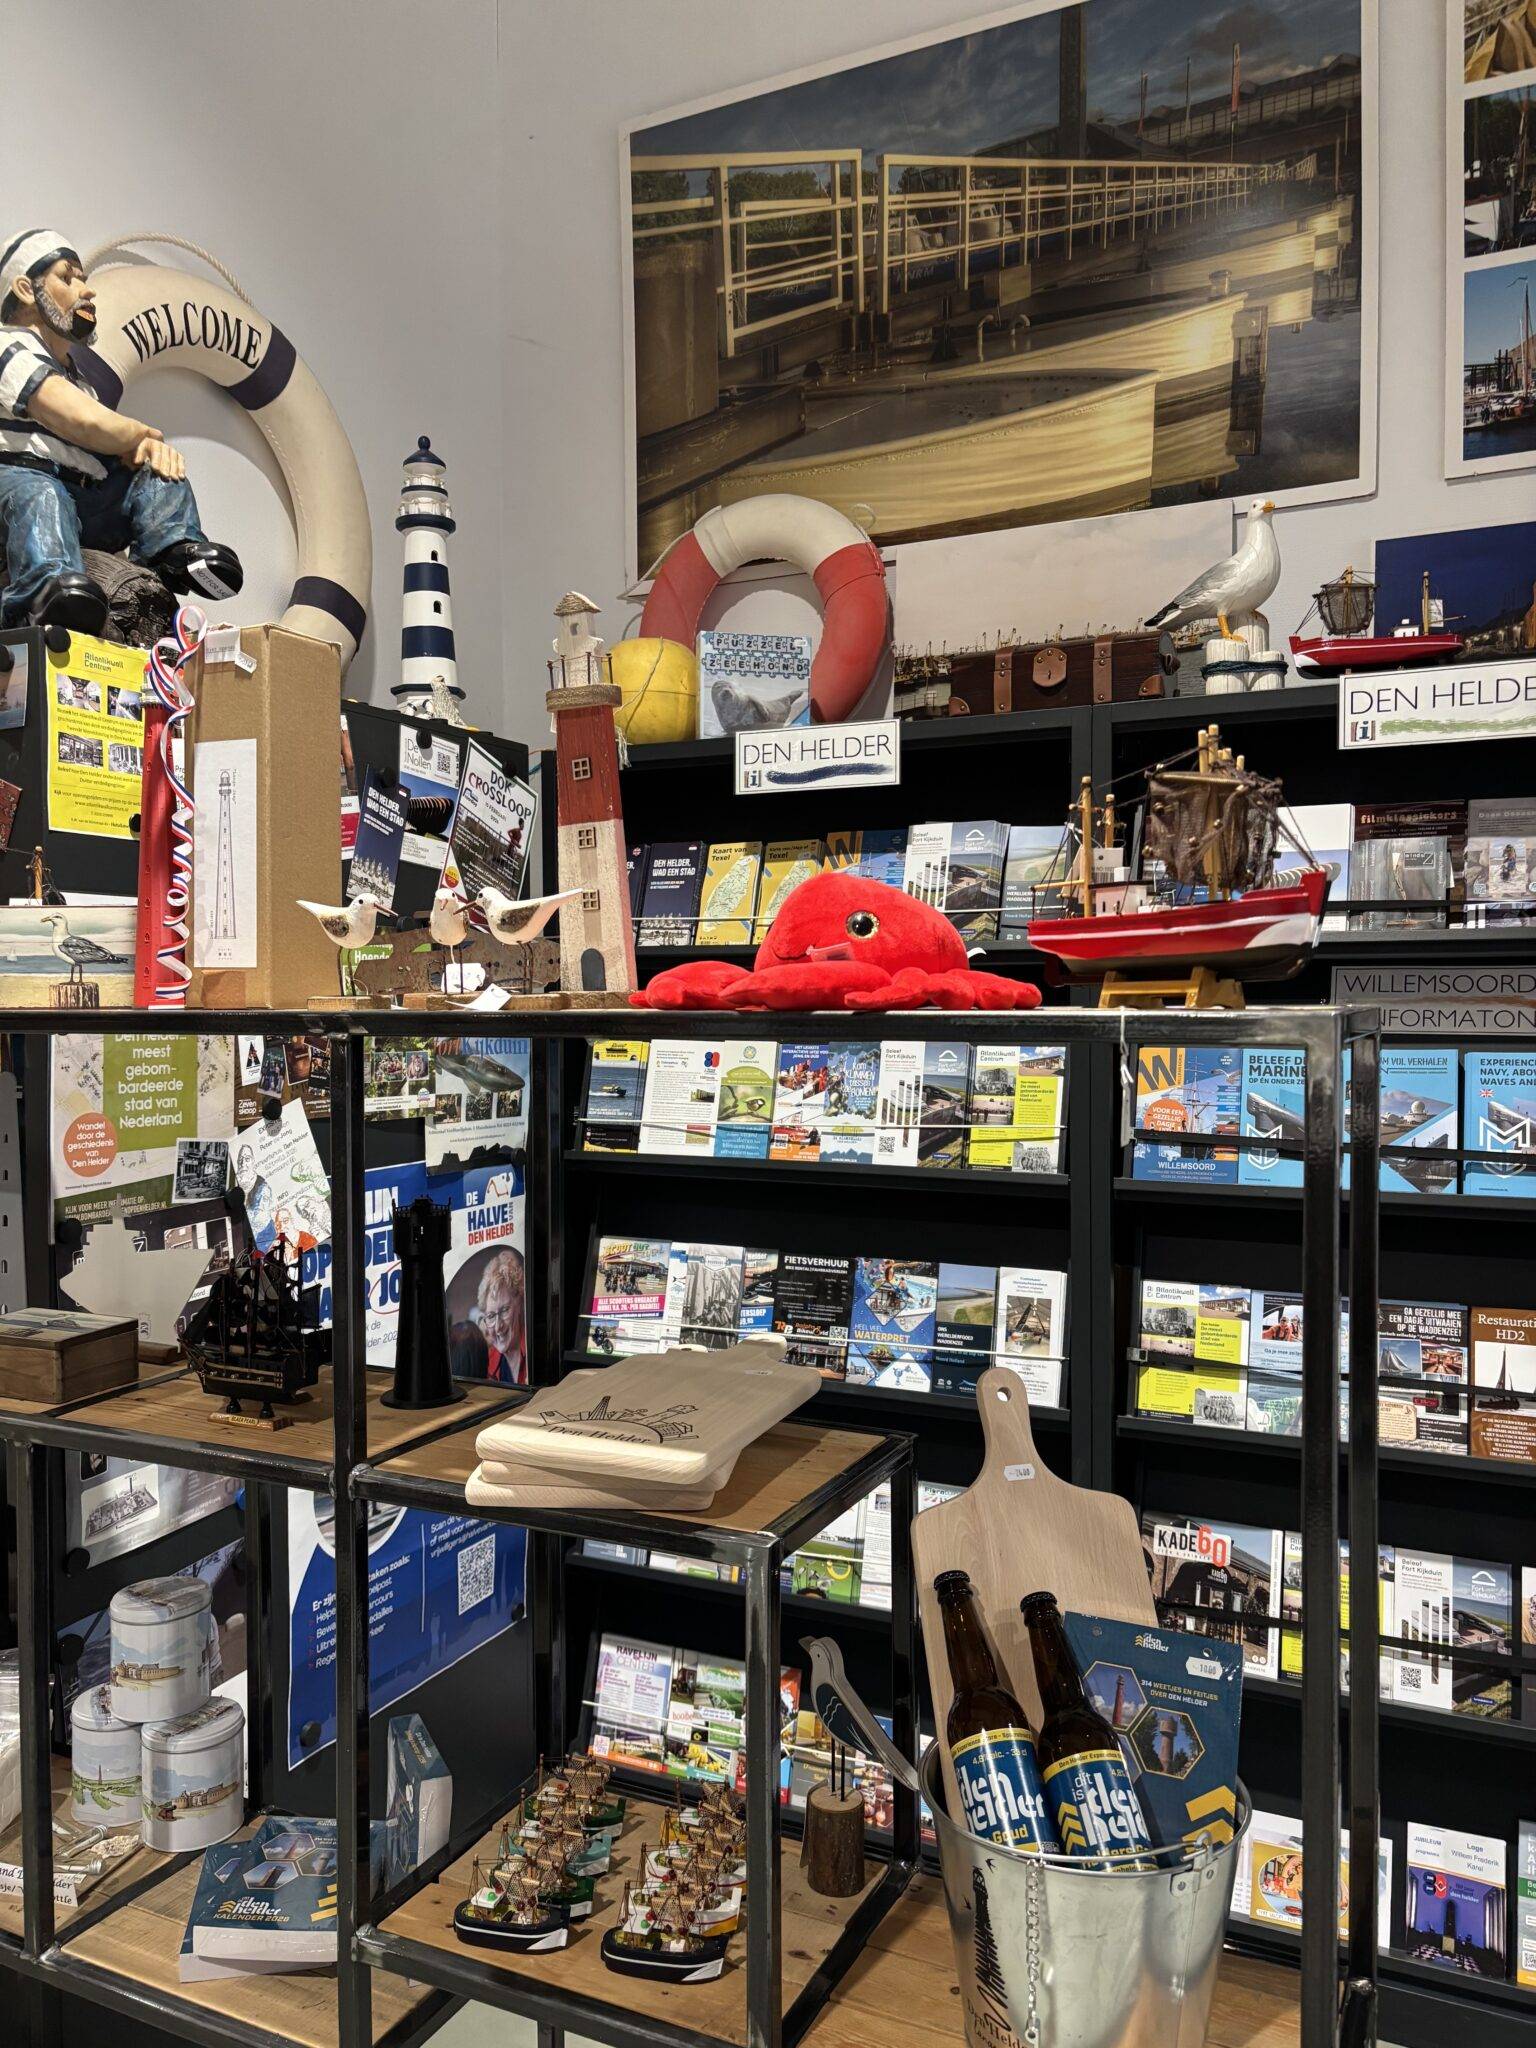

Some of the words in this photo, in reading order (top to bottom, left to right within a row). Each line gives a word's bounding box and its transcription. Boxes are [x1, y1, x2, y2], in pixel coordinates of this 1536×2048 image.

[121, 301, 263, 369] WELCOME
[716, 638, 798, 652] PUZZEL
[84, 652, 124, 669] Atlantikwall
[84, 660, 112, 673] Centrum
[709, 659, 804, 673] ZEEHOND
[1350, 686, 1418, 715] DEN
[1432, 676, 1536, 708] HELDE
[744, 742, 792, 765] DEN
[801, 734, 892, 761] HELDER
[407, 752, 432, 771] Nollen
[490, 770, 512, 795] DOK
[368, 786, 381, 799] DEN
[468, 772, 532, 820] CROSSLOOP
[367, 797, 379, 811] WAD
[379, 803, 389, 817] EEN
[389, 809, 405, 827] STAD
[711, 854, 731, 862] Texel
[768, 851, 788, 859] Texel
[653, 859, 667, 868] DEN
[652, 868, 665, 877] WAD
[667, 867, 679, 877] EEN
[680, 867, 696, 876] STAD
[1343, 974, 1536, 993] WILLEMSOORD
[1380, 1009, 1536, 1028] NFORMATON
[132, 1045, 171, 1059] meest
[1249, 1054, 1291, 1065] BELEEF
[1391, 1058, 1406, 1066] VOL
[1407, 1057, 1448, 1066] VERHALEN
[1479, 1058, 1536, 1067] EXPERIENC
[125, 1063, 177, 1080] gebom-
[1248, 1065, 1307, 1078] MARINE
[1480, 1068, 1509, 1077] NAVY,
[1512, 1068, 1536, 1076] ABOV
[118, 1079, 184, 1094] bardeerde
[1479, 1077, 1517, 1086] WAVES
[124, 1096, 152, 1111] stad
[156, 1097, 178, 1109] van
[238, 1100, 256, 1108] Zeven
[1152, 1106, 1168, 1116] VOOR
[1171, 1108, 1184, 1117] EEN
[1152, 1113, 1182, 1122] GEZELLIG
[77, 1120, 106, 1131] Wandel
[119, 1111, 182, 1129] Nederland
[76, 1132, 94, 1141] door
[95, 1130, 106, 1139] de
[67, 1138, 115, 1153] geschiedenis
[85, 1150, 99, 1158] van
[72, 1159, 87, 1168] Den
[87, 1157, 109, 1167] Helder
[1157, 1161, 1216, 1171] WILLEMSOORD
[466, 1191, 478, 1206] DE
[467, 1203, 508, 1232] HALVE
[468, 1230, 484, 1246] DEN
[485, 1222, 514, 1242] HELDER
[784, 1255, 849, 1269] FIETSVERHUUR
[1155, 1292, 1182, 1300] Centrum
[1403, 1307, 1413, 1316] GA
[1415, 1308, 1445, 1318] GEZELLIG
[1447, 1310, 1462, 1319] MEE
[1389, 1314, 1402, 1323] EEN
[1404, 1315, 1424, 1325] DAGJE
[1425, 1317, 1462, 1328] UITWAAIEN
[1477, 1313, 1536, 1328] Restaurati
[854, 1323, 868, 1331] HEEL
[869, 1324, 883, 1332] VEEL
[1397, 1323, 1407, 1332] OP
[1408, 1324, 1417, 1333] DE
[854, 1330, 911, 1344] WATERPRET
[1495, 1329, 1525, 1341] HD2
[589, 1428, 651, 1444] Helder
[431, 1520, 447, 1534] Scan
[451, 1523, 465, 1535] voor
[390, 1555, 411, 1573] zoals:
[1401, 1559, 1423, 1567] Beleef
[1401, 1565, 1415, 1573] Fort
[1416, 1567, 1443, 1577] Kijkduin
[1471, 1591, 1497, 1600] Kijkduin
[312, 1599, 322, 1612] Er
[616, 1645, 658, 1662] RAVELIJN
[1153, 1681, 1182, 1692] WEETJES
[1193, 1690, 1218, 1701] FEITJES
[1150, 1690, 1168, 1699] OVER
[1168, 1693, 1181, 1702] DEN
[1182, 1696, 1208, 1707] HELDER
[1059, 1758, 1069, 1768] Den
[1088, 1751, 1119, 1760] Experience
[1074, 1772, 1093, 1788] dit
[1072, 1788, 1085, 1802] is
[992, 1825, 1029, 1844] Goud
[1414, 1836, 1441, 1846] JUBILEUM
[1466, 1843, 1484, 1853] Loge
[1451, 1850, 1473, 1860] Willem
[1473, 1855, 1500, 1867] Frederik
[1466, 1863, 1484, 1872] Karel
[1450, 1891, 1461, 1899] den
[1461, 1894, 1480, 1903] helder
[232, 1903, 281, 1915] helder
[213, 1913, 265, 1921] KALENDER
